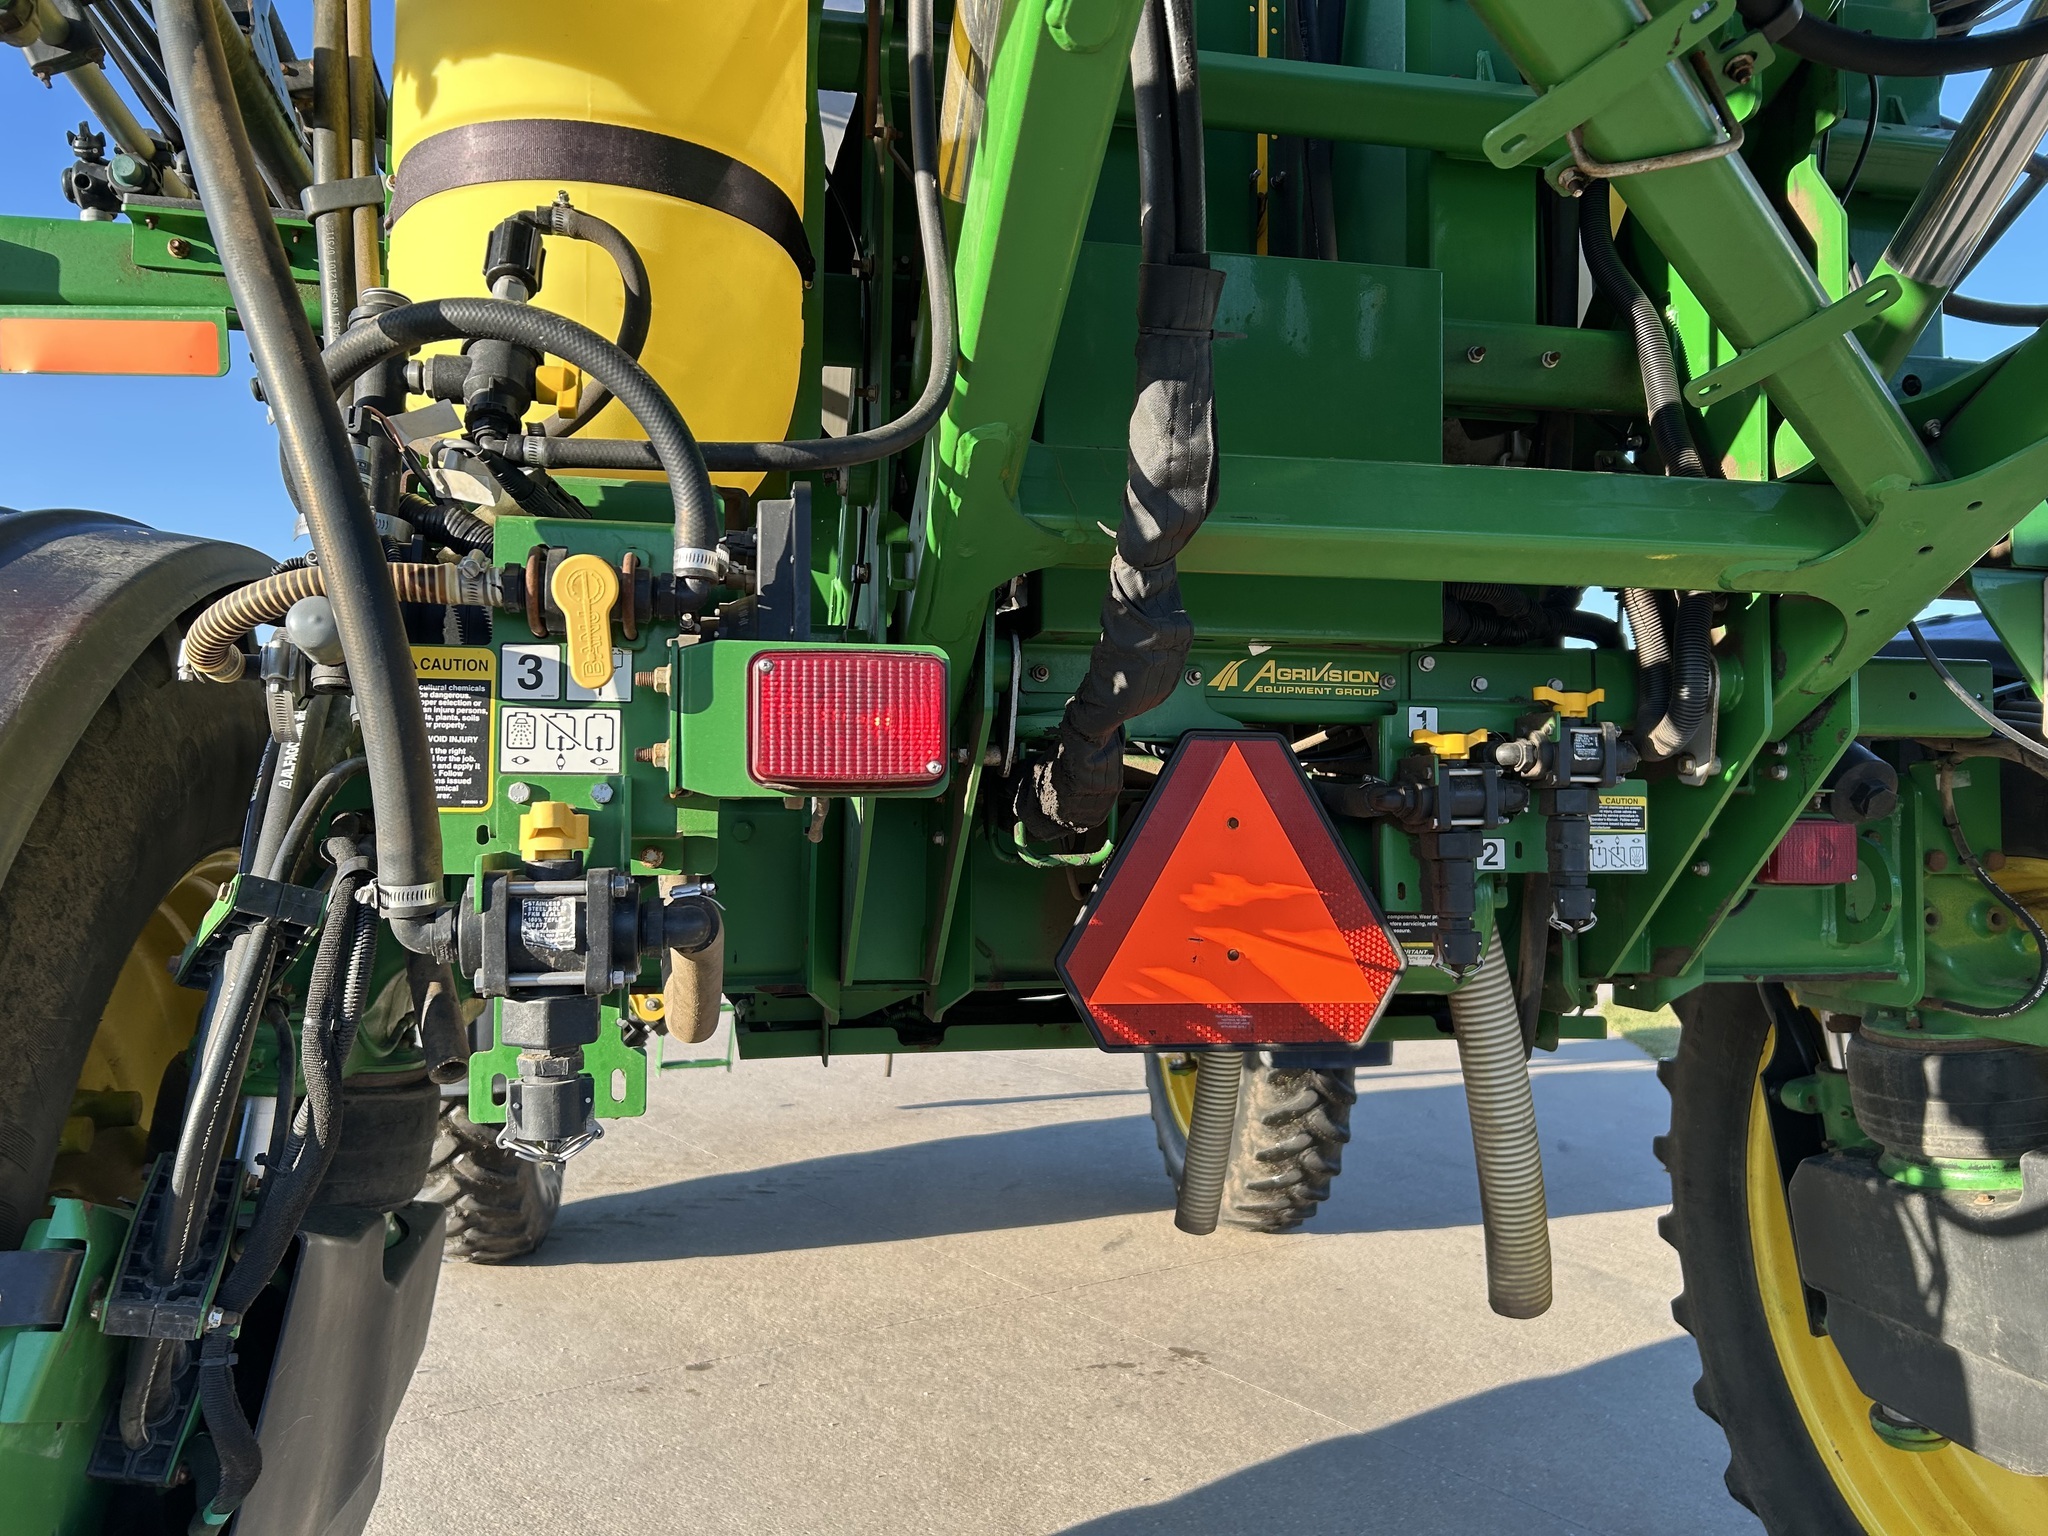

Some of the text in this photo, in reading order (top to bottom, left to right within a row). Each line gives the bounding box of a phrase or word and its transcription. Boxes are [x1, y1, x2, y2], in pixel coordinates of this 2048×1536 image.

[420, 658, 489, 672] CAUTION
[517, 654, 544, 690] 3
[448, 684, 486, 692] chemicals
[1256, 686, 1380, 696] EQUIPMENT GROUP
[429, 691, 471, 699] dangerous.
[433, 706, 455, 715] injure
[456, 707, 488, 715] persons,
[435, 714, 460, 722] plants,
[462, 714, 480, 722] soils
[1417, 710, 1427, 730] 1
[433, 722, 467, 730] property.
[428, 735, 448, 743] VOID
[448, 748, 466, 756] right
[462, 755, 476, 764] job.
[452, 763, 474, 771] apply
[1483, 842, 1499, 866] 2
